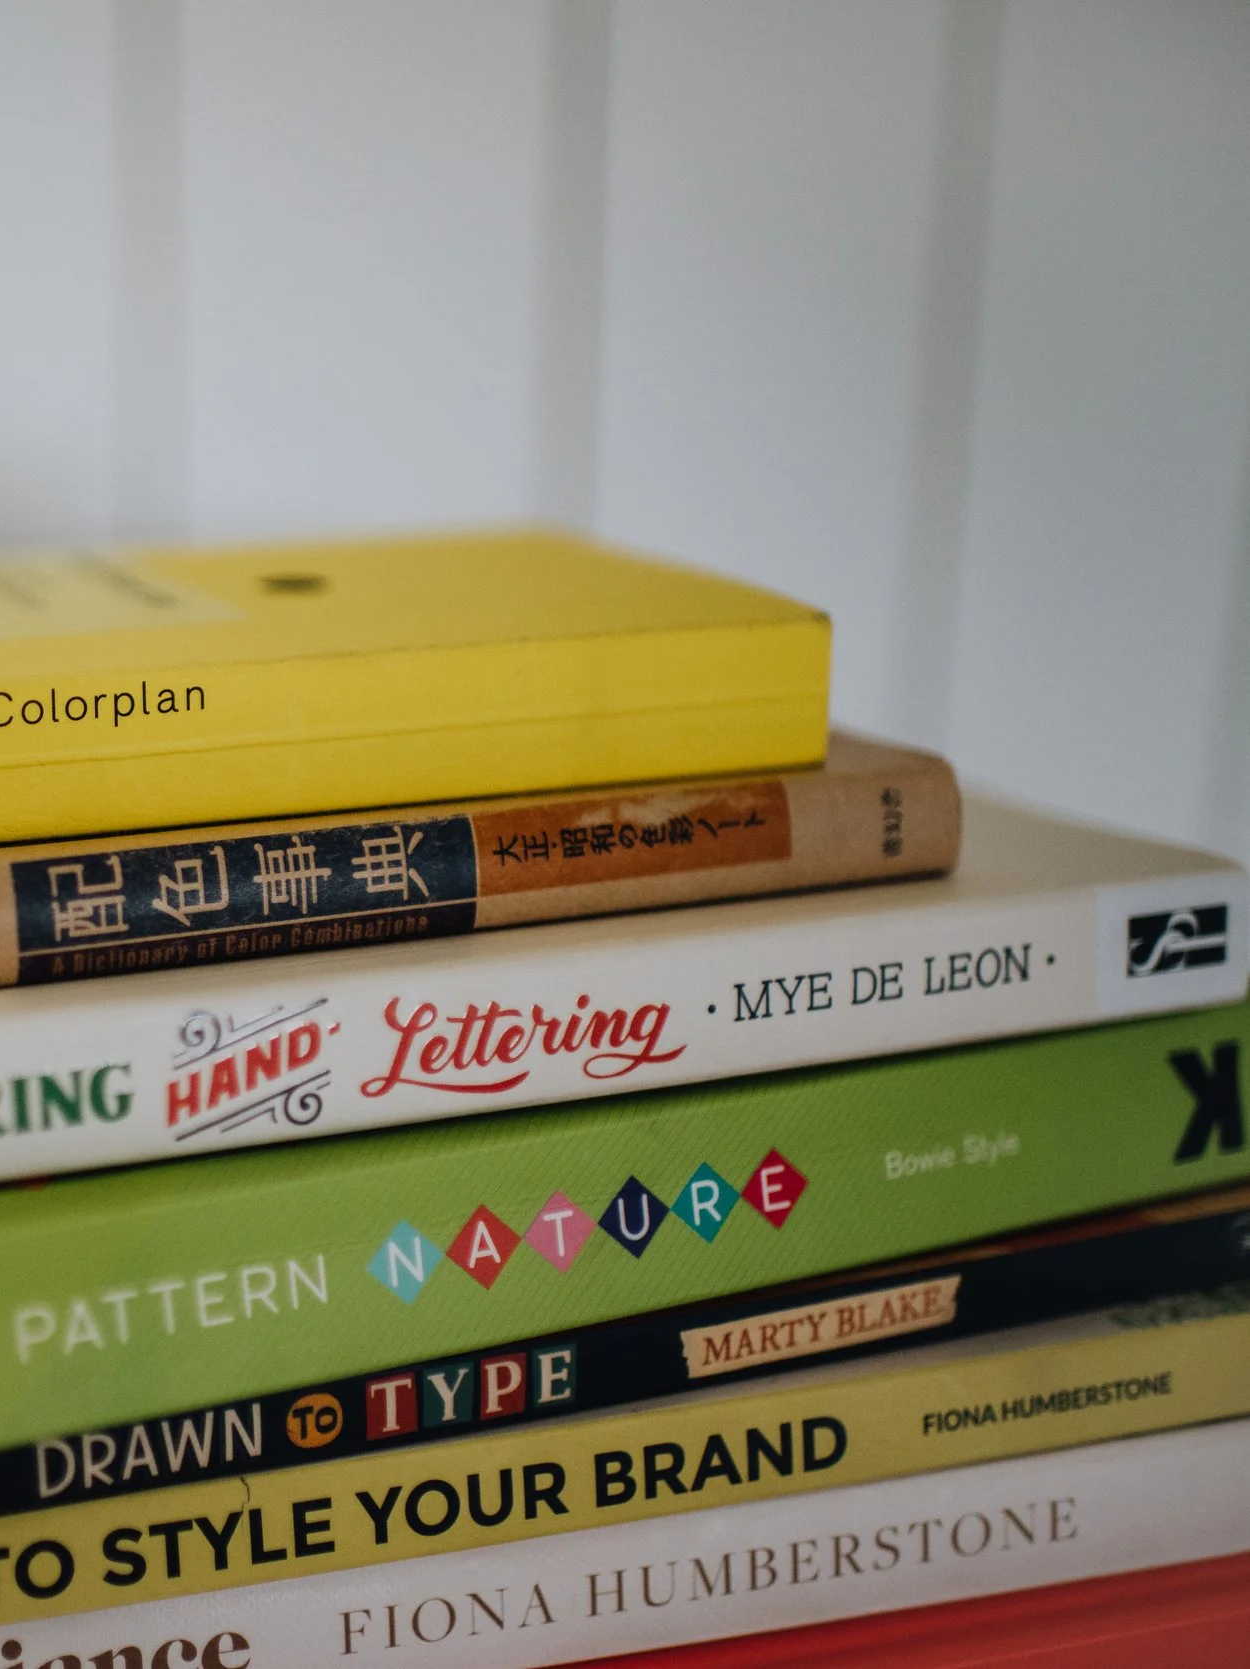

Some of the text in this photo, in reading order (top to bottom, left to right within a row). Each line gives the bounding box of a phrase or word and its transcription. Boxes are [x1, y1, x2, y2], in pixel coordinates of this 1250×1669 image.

[47, 824, 430, 942] 配色事典
[52, 914, 429, 976] A Dictionary of Color Combinations
[733, 943, 1032, 1023] MYE DE LEON
[360, 993, 688, 1099] Lettering
[884, 1146, 955, 1180] Bowie
[11, 1252, 330, 1364] PATTERN
[385, 1164, 791, 1289] NATURE
[700, 1284, 944, 1368] MARTY BLAKE
[36, 1349, 574, 1499] DRAWN TO TYPE
[922, 1371, 1174, 1438] FIONA HUMBERSTONE
[101, 1497, 336, 1587] STYLE
[356, 1460, 568, 1546] YOUR
[593, 1415, 849, 1509] BRAND
[338, 1497, 1080, 1657] FIONA HUMBERSTONE
